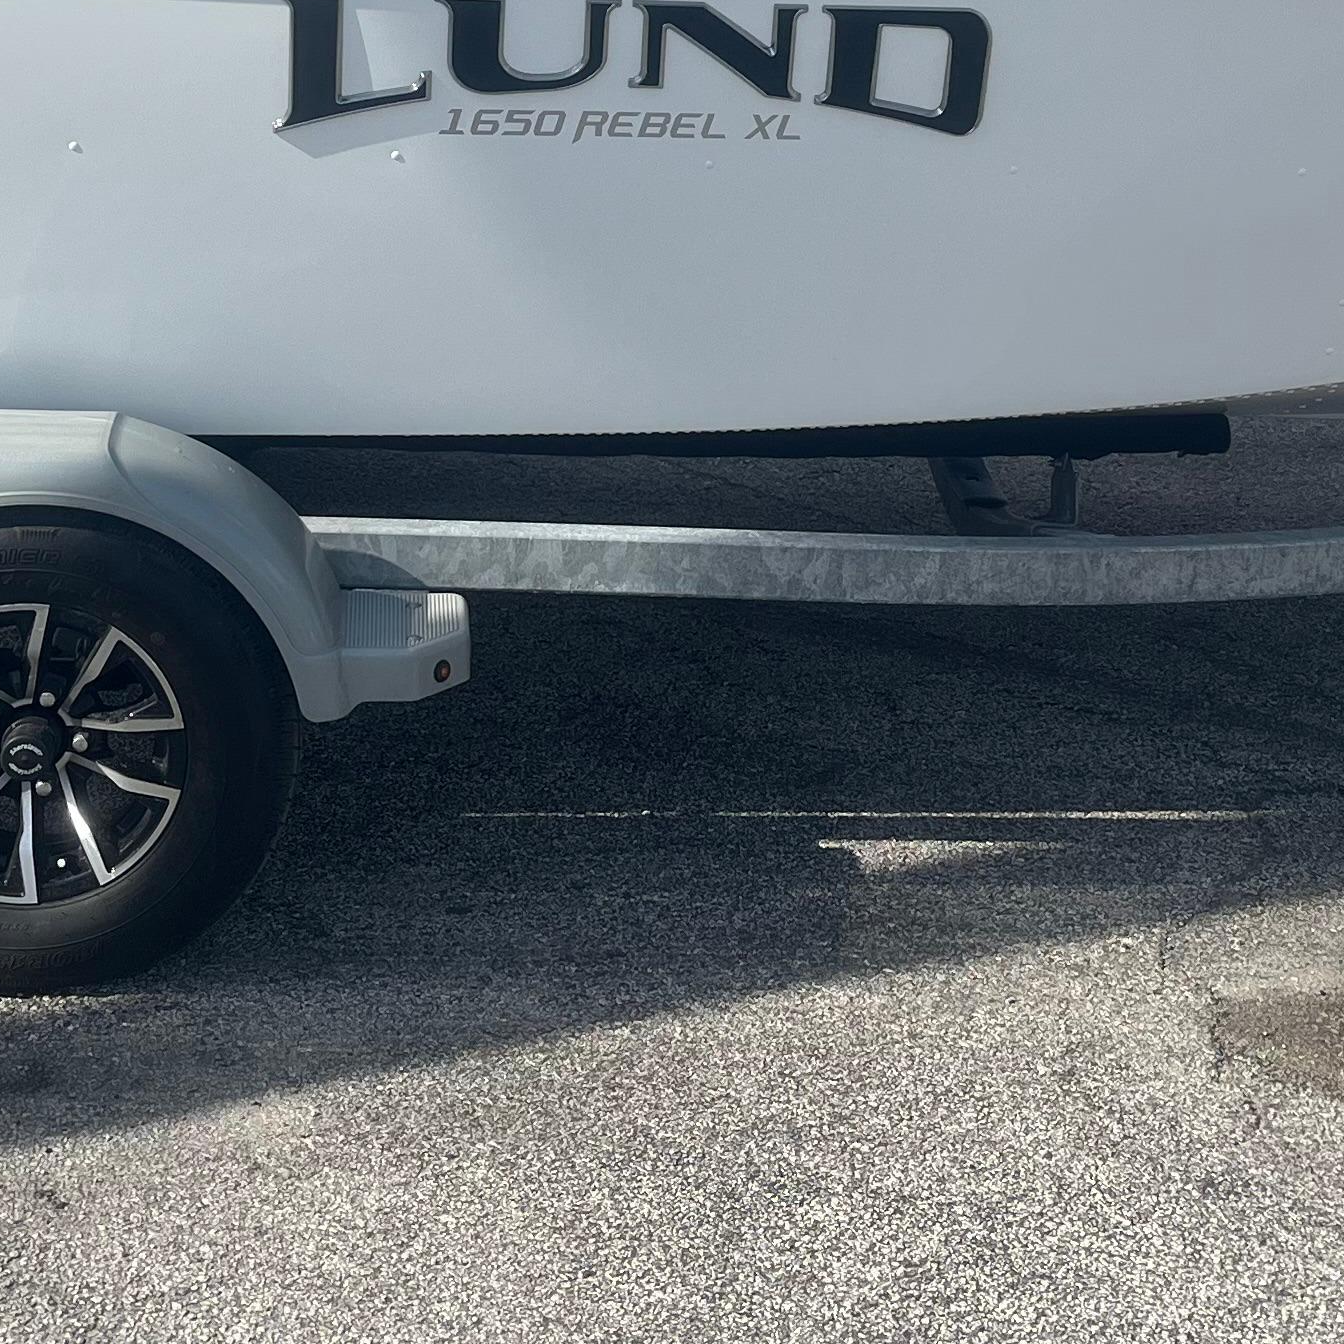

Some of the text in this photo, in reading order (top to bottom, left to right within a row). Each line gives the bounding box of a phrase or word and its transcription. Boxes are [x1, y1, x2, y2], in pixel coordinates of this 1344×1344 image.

[438, 107, 801, 144] 1650 REBEL XL
